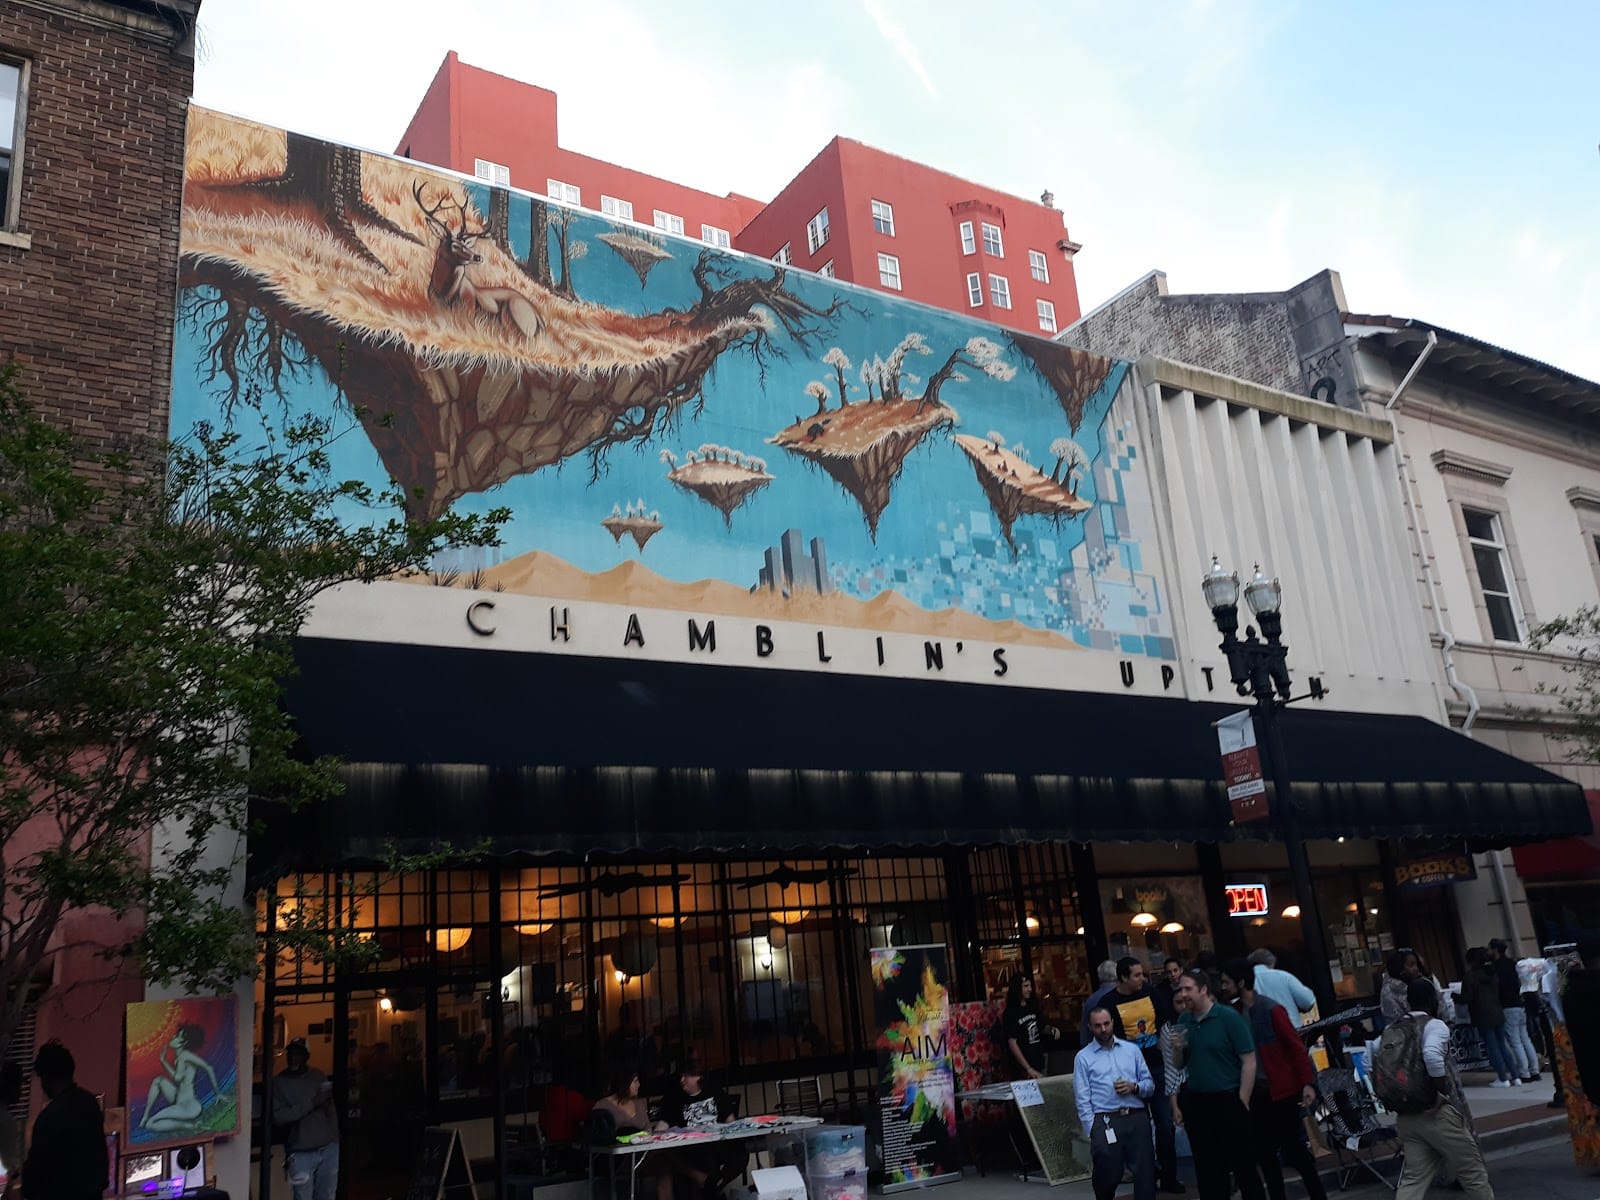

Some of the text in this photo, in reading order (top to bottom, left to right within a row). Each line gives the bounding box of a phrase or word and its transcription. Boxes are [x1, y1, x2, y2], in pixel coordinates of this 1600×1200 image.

[466, 600, 1323, 701] CHAMBLIN'S UPTN
[1393, 857, 1472, 886] BOOKS
[1225, 887, 1266, 912] OPEN
[901, 1033, 947, 1061] AIM
